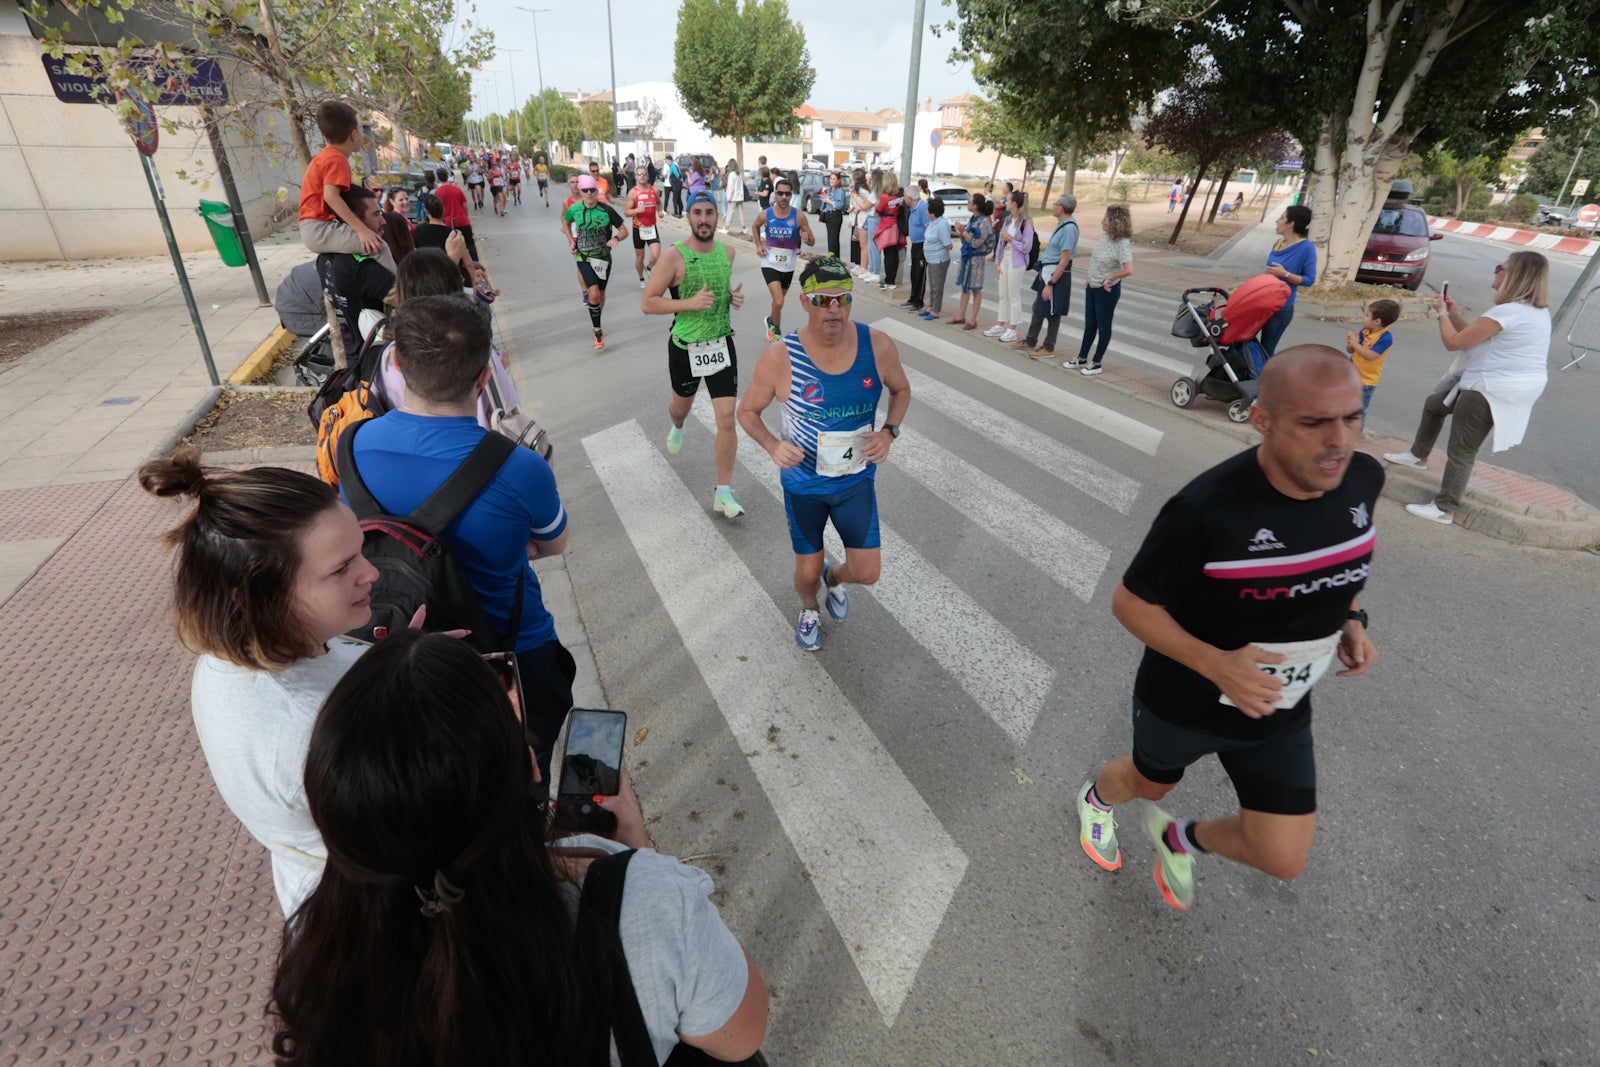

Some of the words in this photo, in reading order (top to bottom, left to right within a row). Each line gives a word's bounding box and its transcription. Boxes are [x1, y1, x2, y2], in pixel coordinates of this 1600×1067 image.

[775, 254, 788, 263] 129
[694, 351, 725, 366] 3048
[803, 402, 873, 420] SONRIALIA
[843, 446, 854, 460] 4
